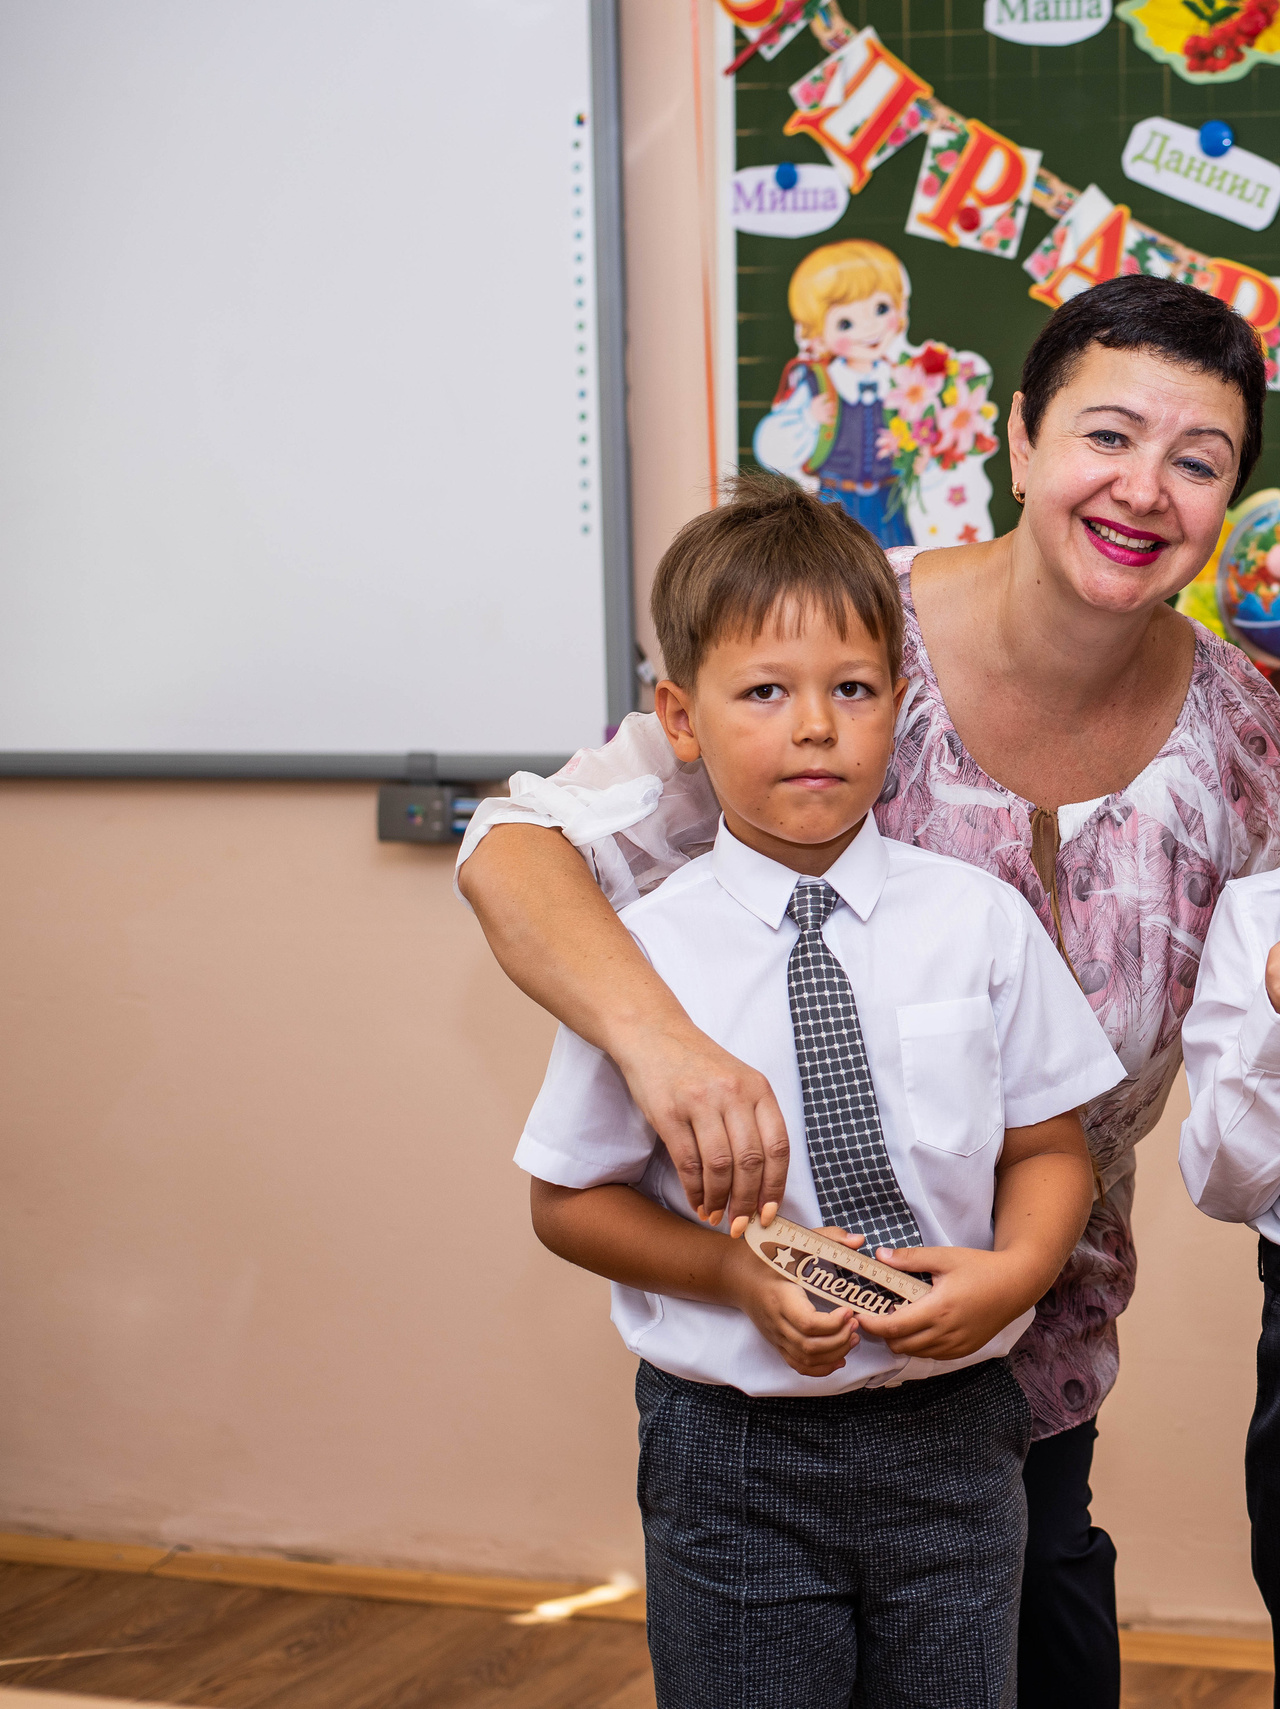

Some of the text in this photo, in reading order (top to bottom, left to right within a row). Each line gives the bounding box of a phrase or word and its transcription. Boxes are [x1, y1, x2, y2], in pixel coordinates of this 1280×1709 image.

[996, 0, 1104, 25] Маша
[1131, 130, 1271, 209] Даниил
[733, 181, 838, 214] Миша
[796, 1254, 890, 1315] Степан
